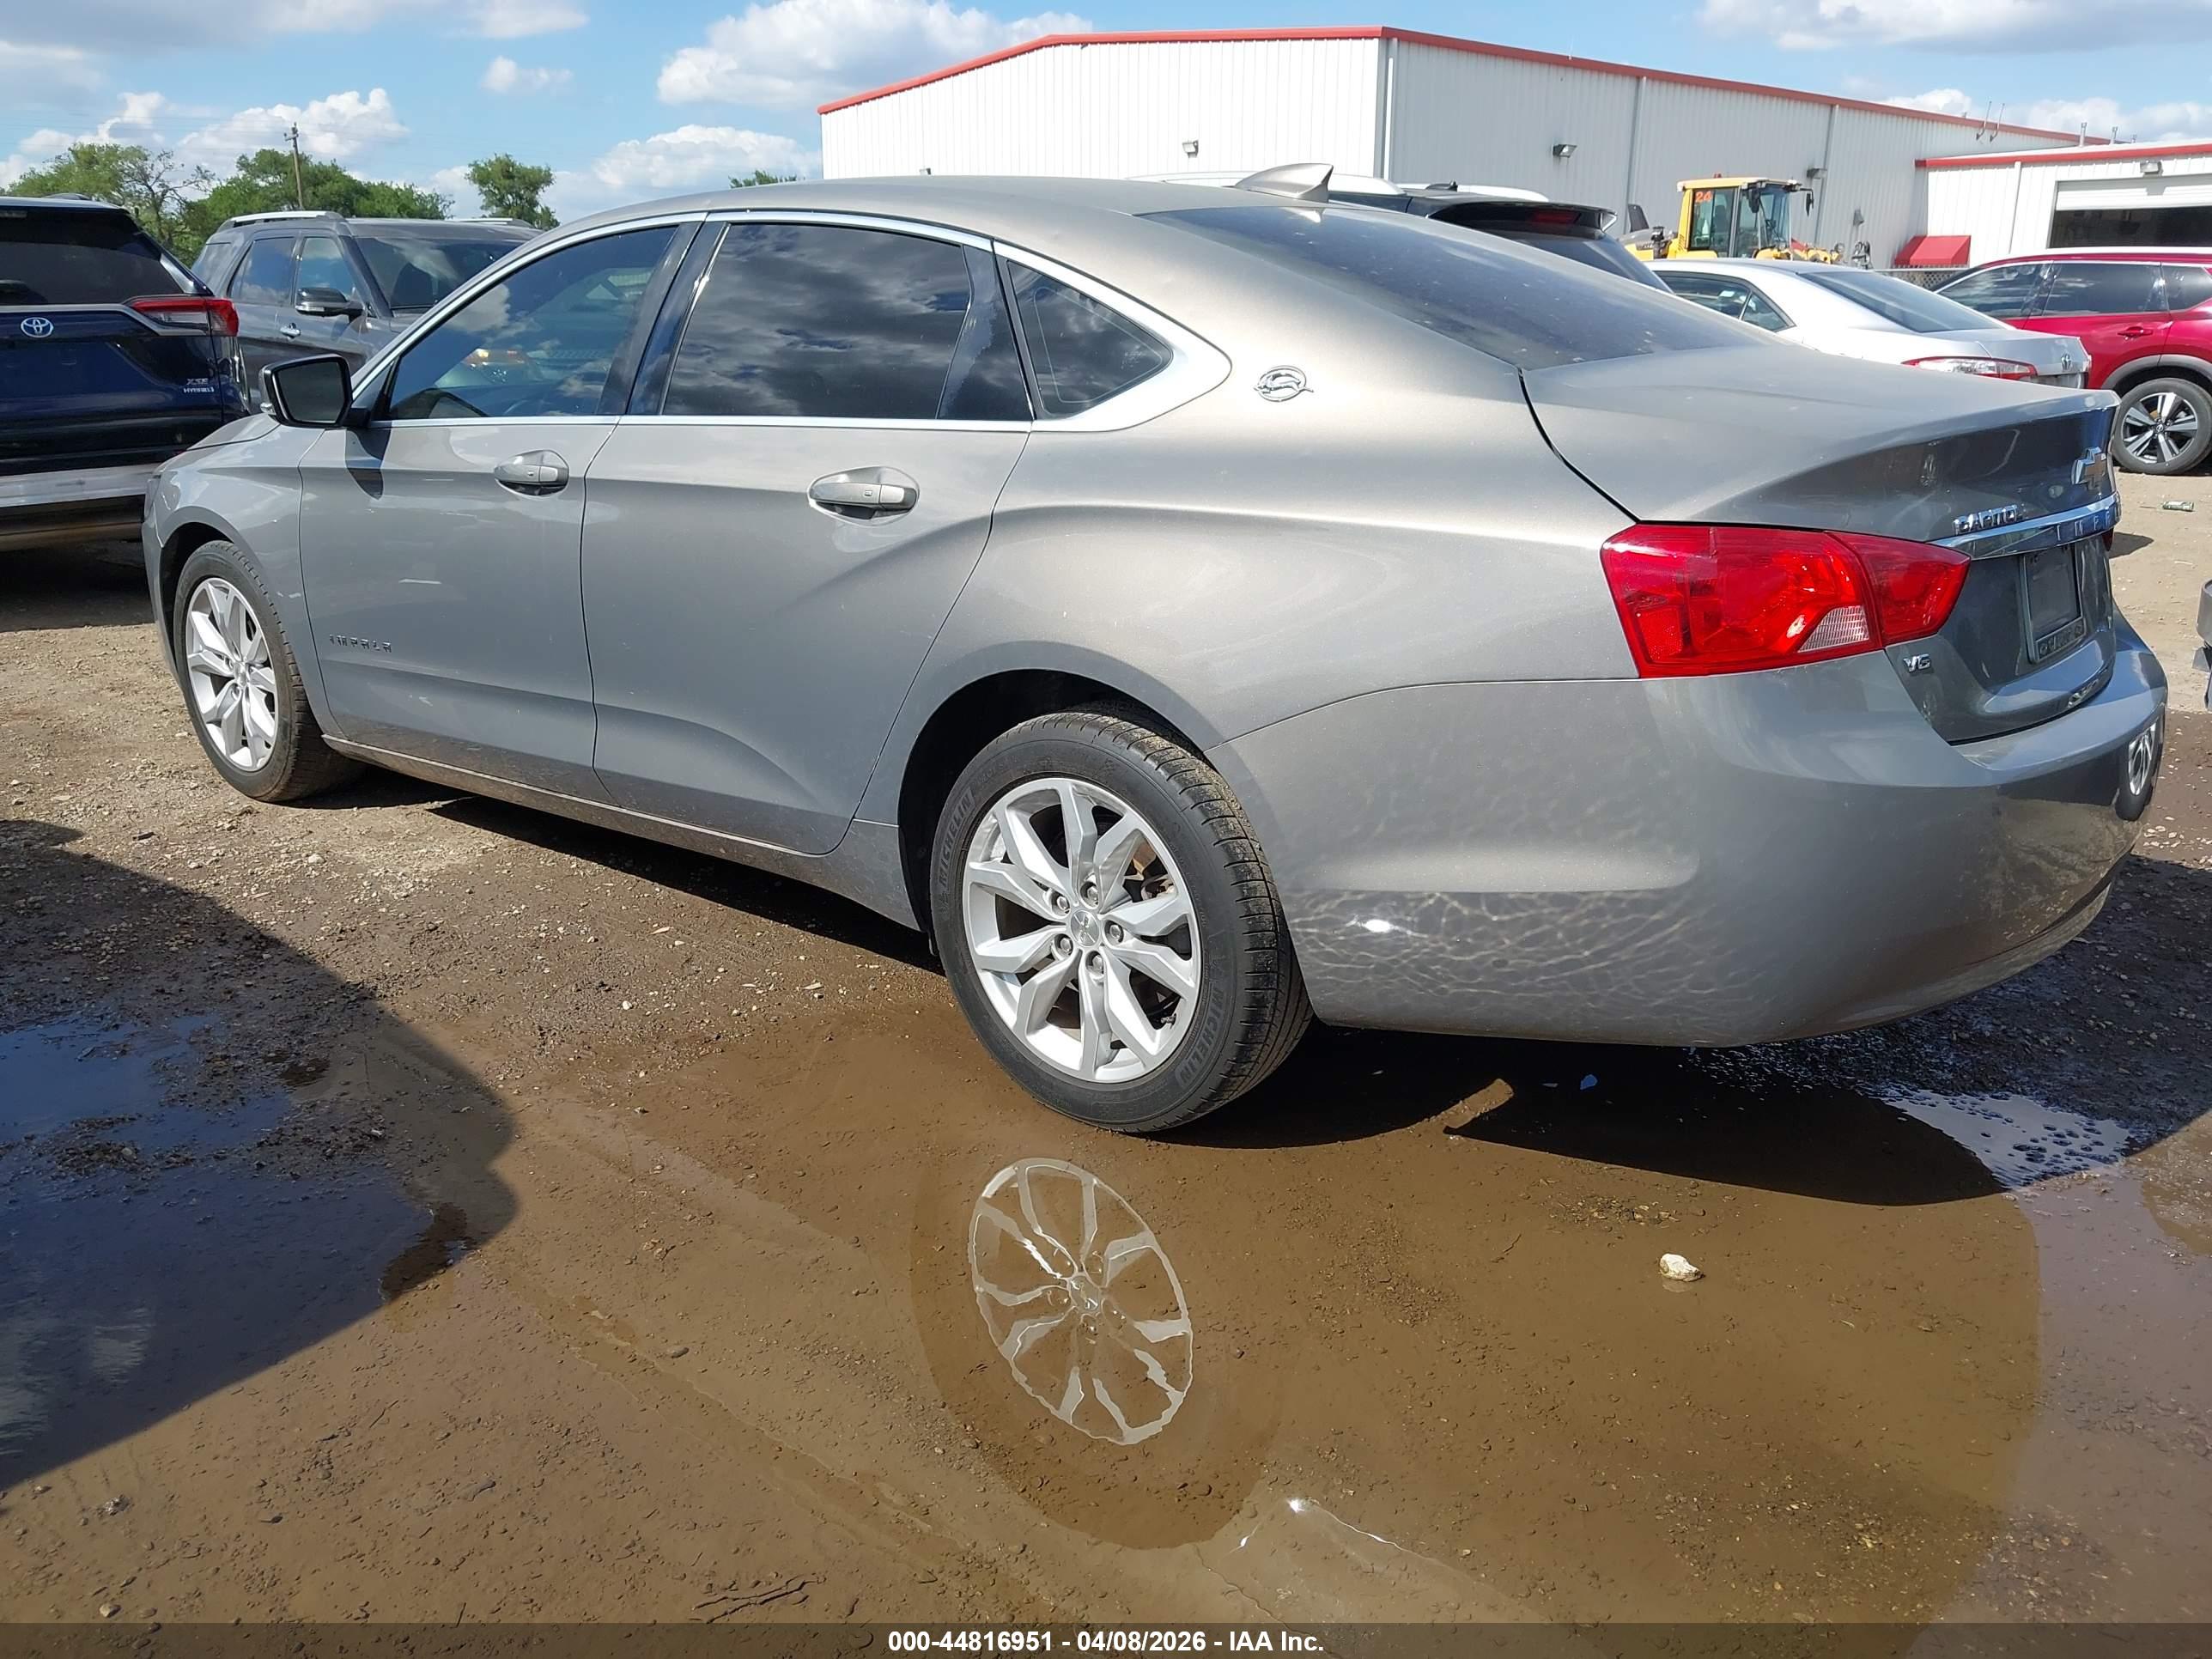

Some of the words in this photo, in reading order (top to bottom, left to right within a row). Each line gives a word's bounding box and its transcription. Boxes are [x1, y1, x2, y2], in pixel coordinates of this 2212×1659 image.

[1695, 190, 1711, 204] 24
[1903, 653, 1930, 672] V6
[939, 789, 974, 887] MICHELIN
[1179, 988, 1224, 1084] MICHELIN
